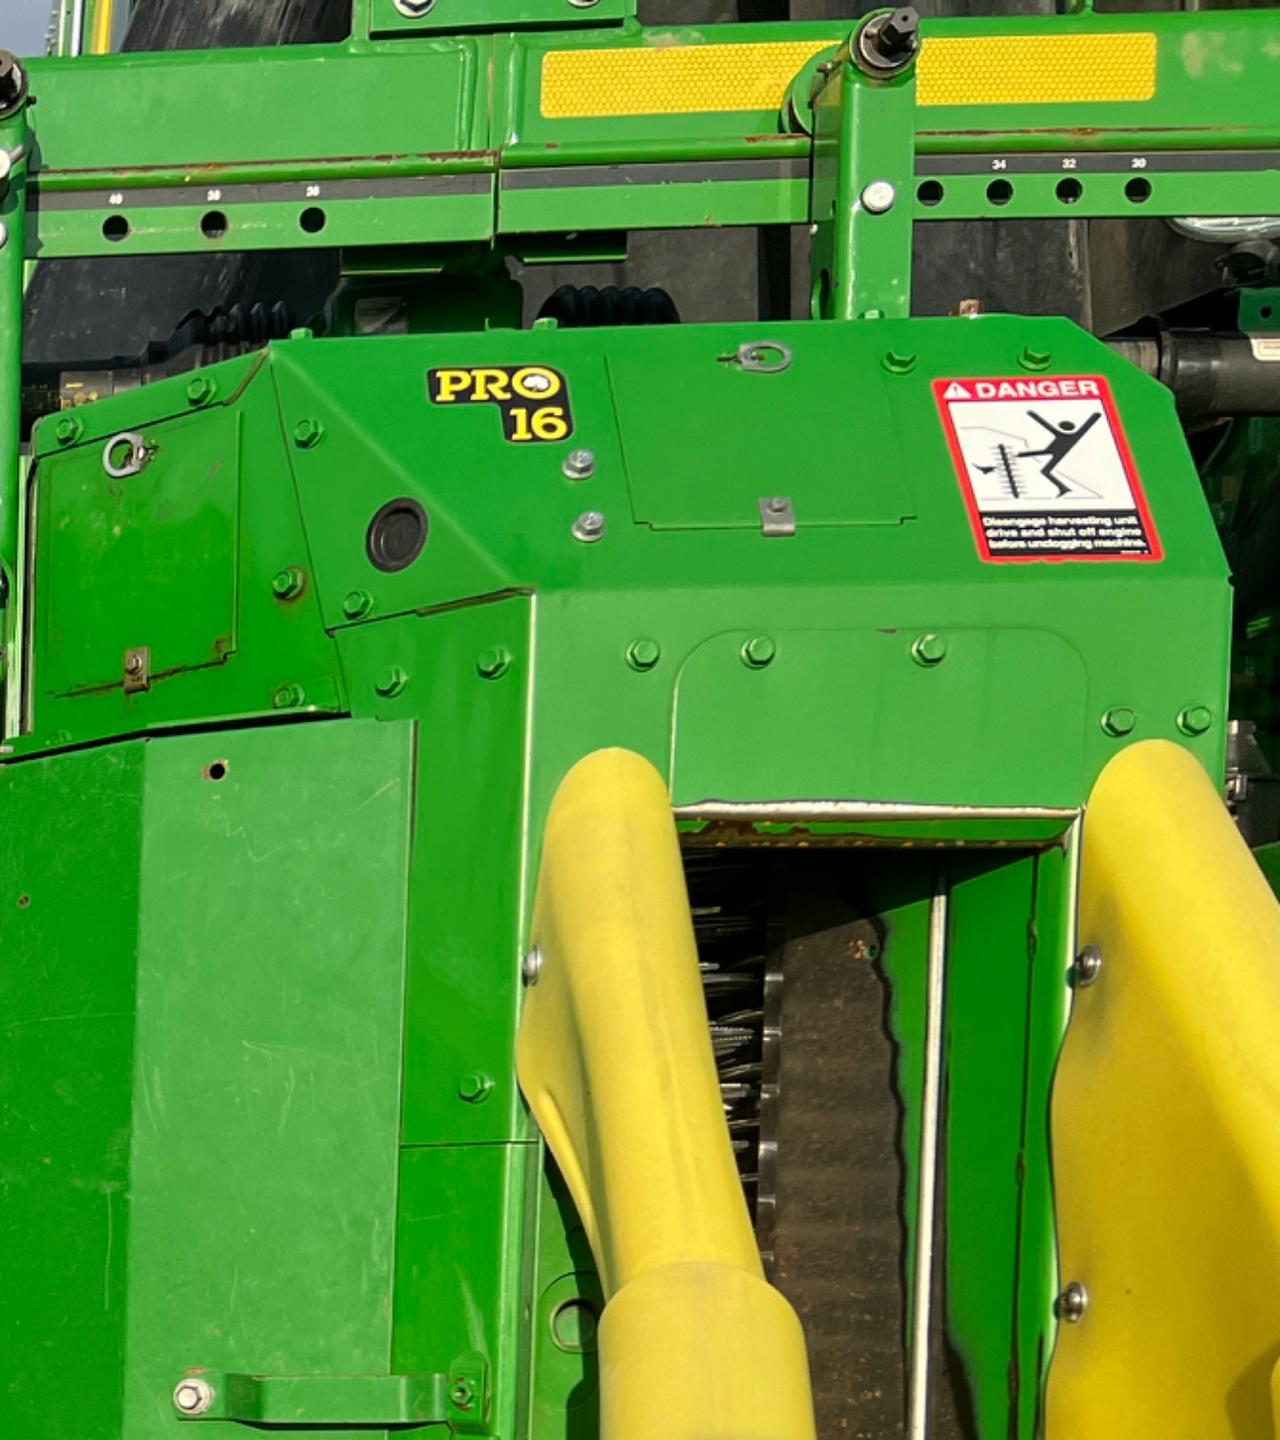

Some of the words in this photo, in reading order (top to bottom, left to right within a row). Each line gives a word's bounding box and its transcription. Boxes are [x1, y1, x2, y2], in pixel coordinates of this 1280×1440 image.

[435, 367, 561, 402] PRO
[975, 381, 1100, 398] DANGER
[509, 406, 568, 441] 16
[983, 517, 1046, 528] Disengage
[1048, 516, 1112, 527] harvesting
[1114, 516, 1138, 525] unit
[986, 528, 1018, 537] drive
[1021, 528, 1045, 537] and
[1047, 528, 1076, 537] shut
[1078, 527, 1096, 536] off
[1099, 528, 1142, 538] engine
[988, 540, 1026, 549] before
[1028, 539, 1093, 550] unclogging
[1095, 539, 1147, 548] machine.
